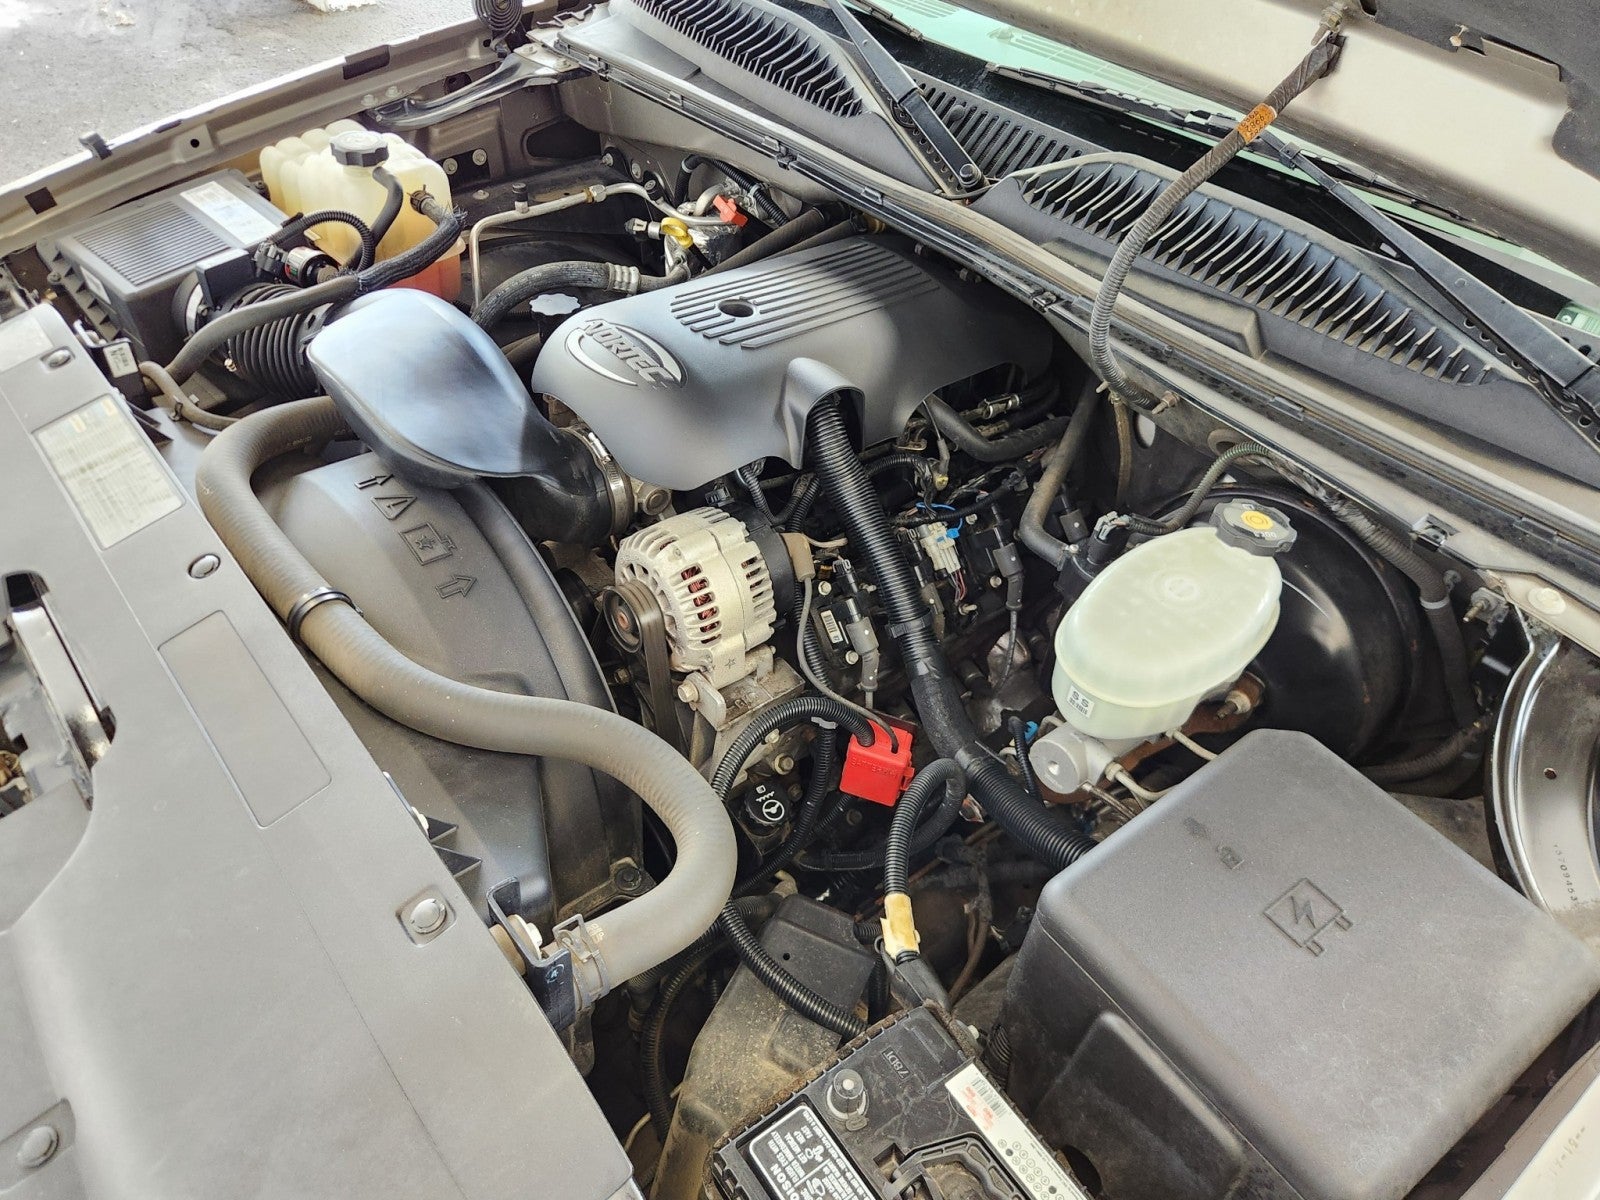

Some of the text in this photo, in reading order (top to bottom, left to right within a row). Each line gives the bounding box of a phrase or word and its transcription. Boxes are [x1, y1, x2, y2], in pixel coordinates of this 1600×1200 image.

[584, 319, 675, 383] VORTEC
[883, 1051, 909, 1078] 78DT
[792, 1129, 806, 1144] HELP
[800, 1124, 813, 1139] FAST
[769, 1162, 801, 1200] OISON
